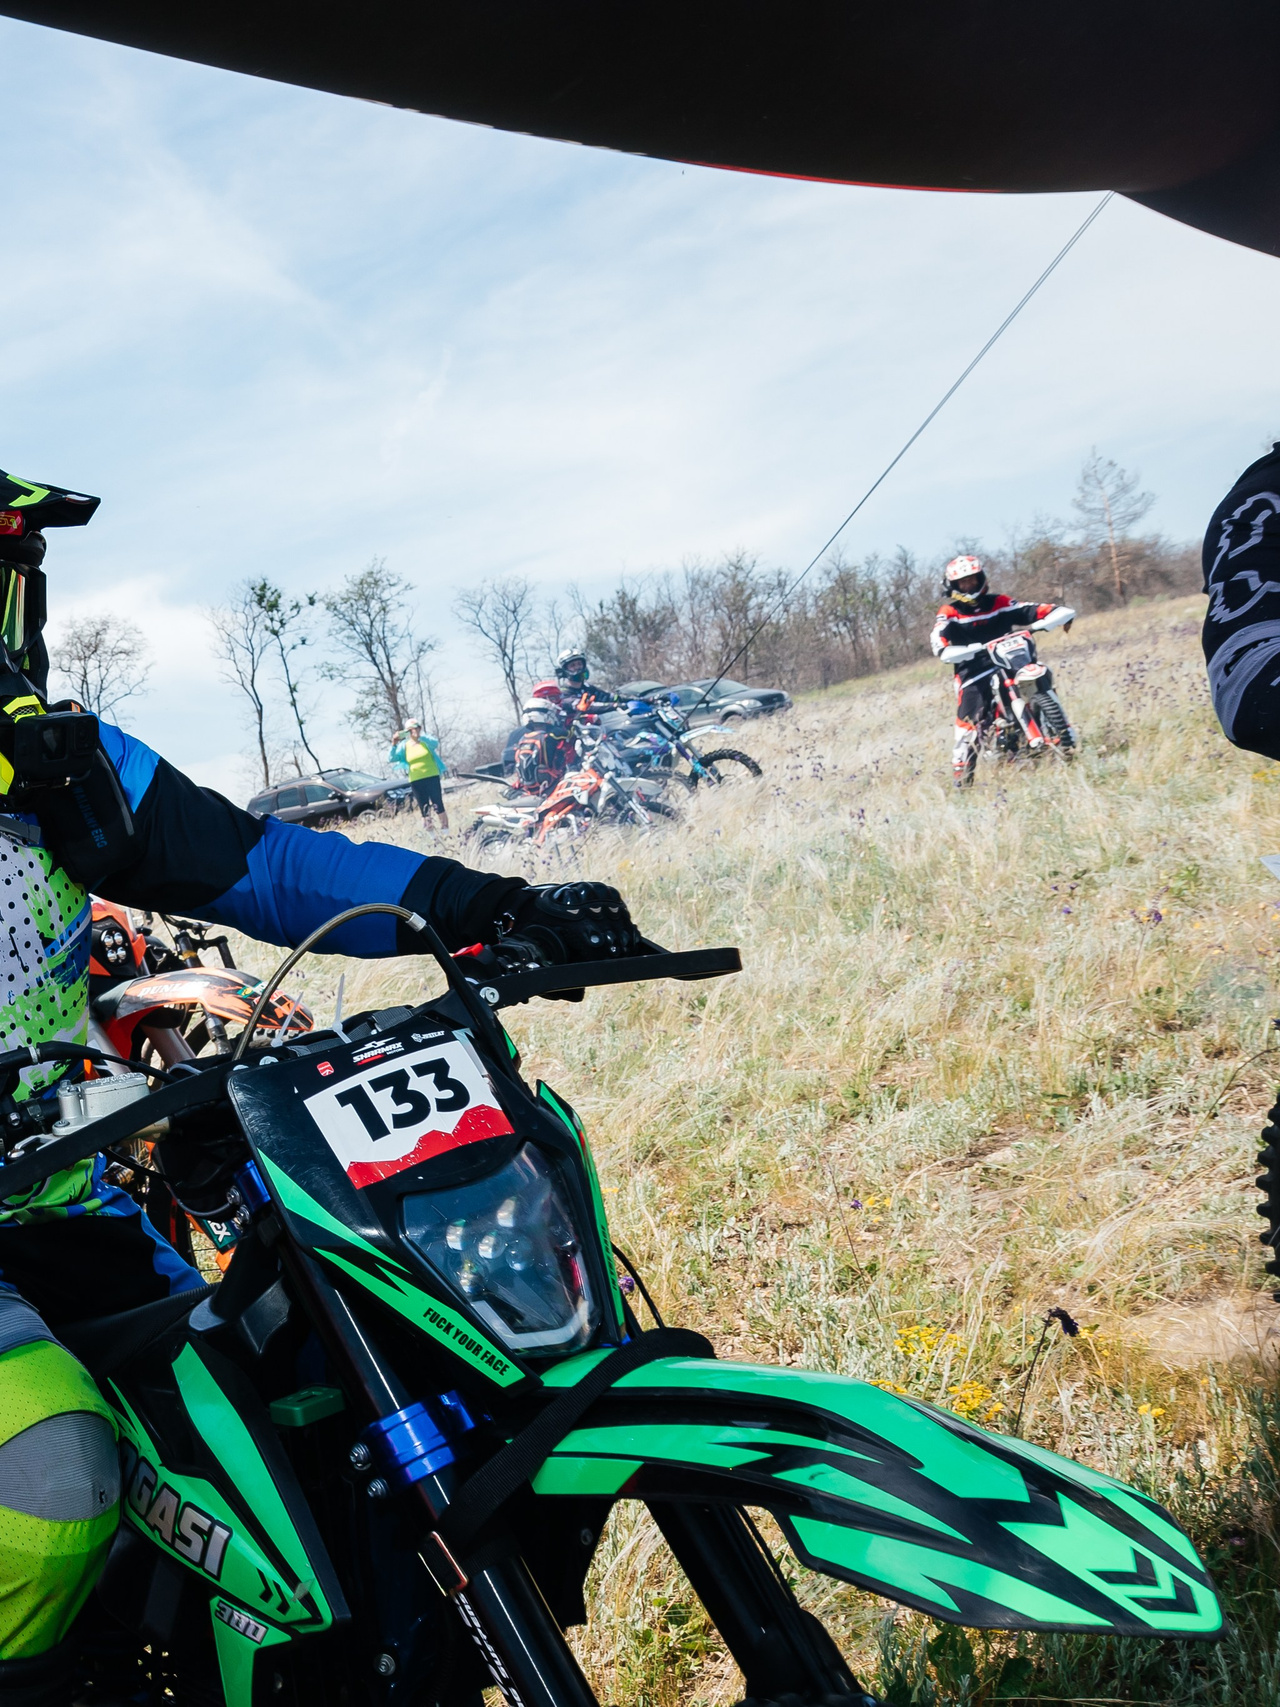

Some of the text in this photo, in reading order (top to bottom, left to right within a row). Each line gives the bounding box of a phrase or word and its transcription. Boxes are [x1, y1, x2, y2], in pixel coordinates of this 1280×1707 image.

[334, 1057, 471, 1142] 133
[422, 1307, 510, 1376] FUCK YOUR FACE
[215, 1601, 269, 1645] 300
